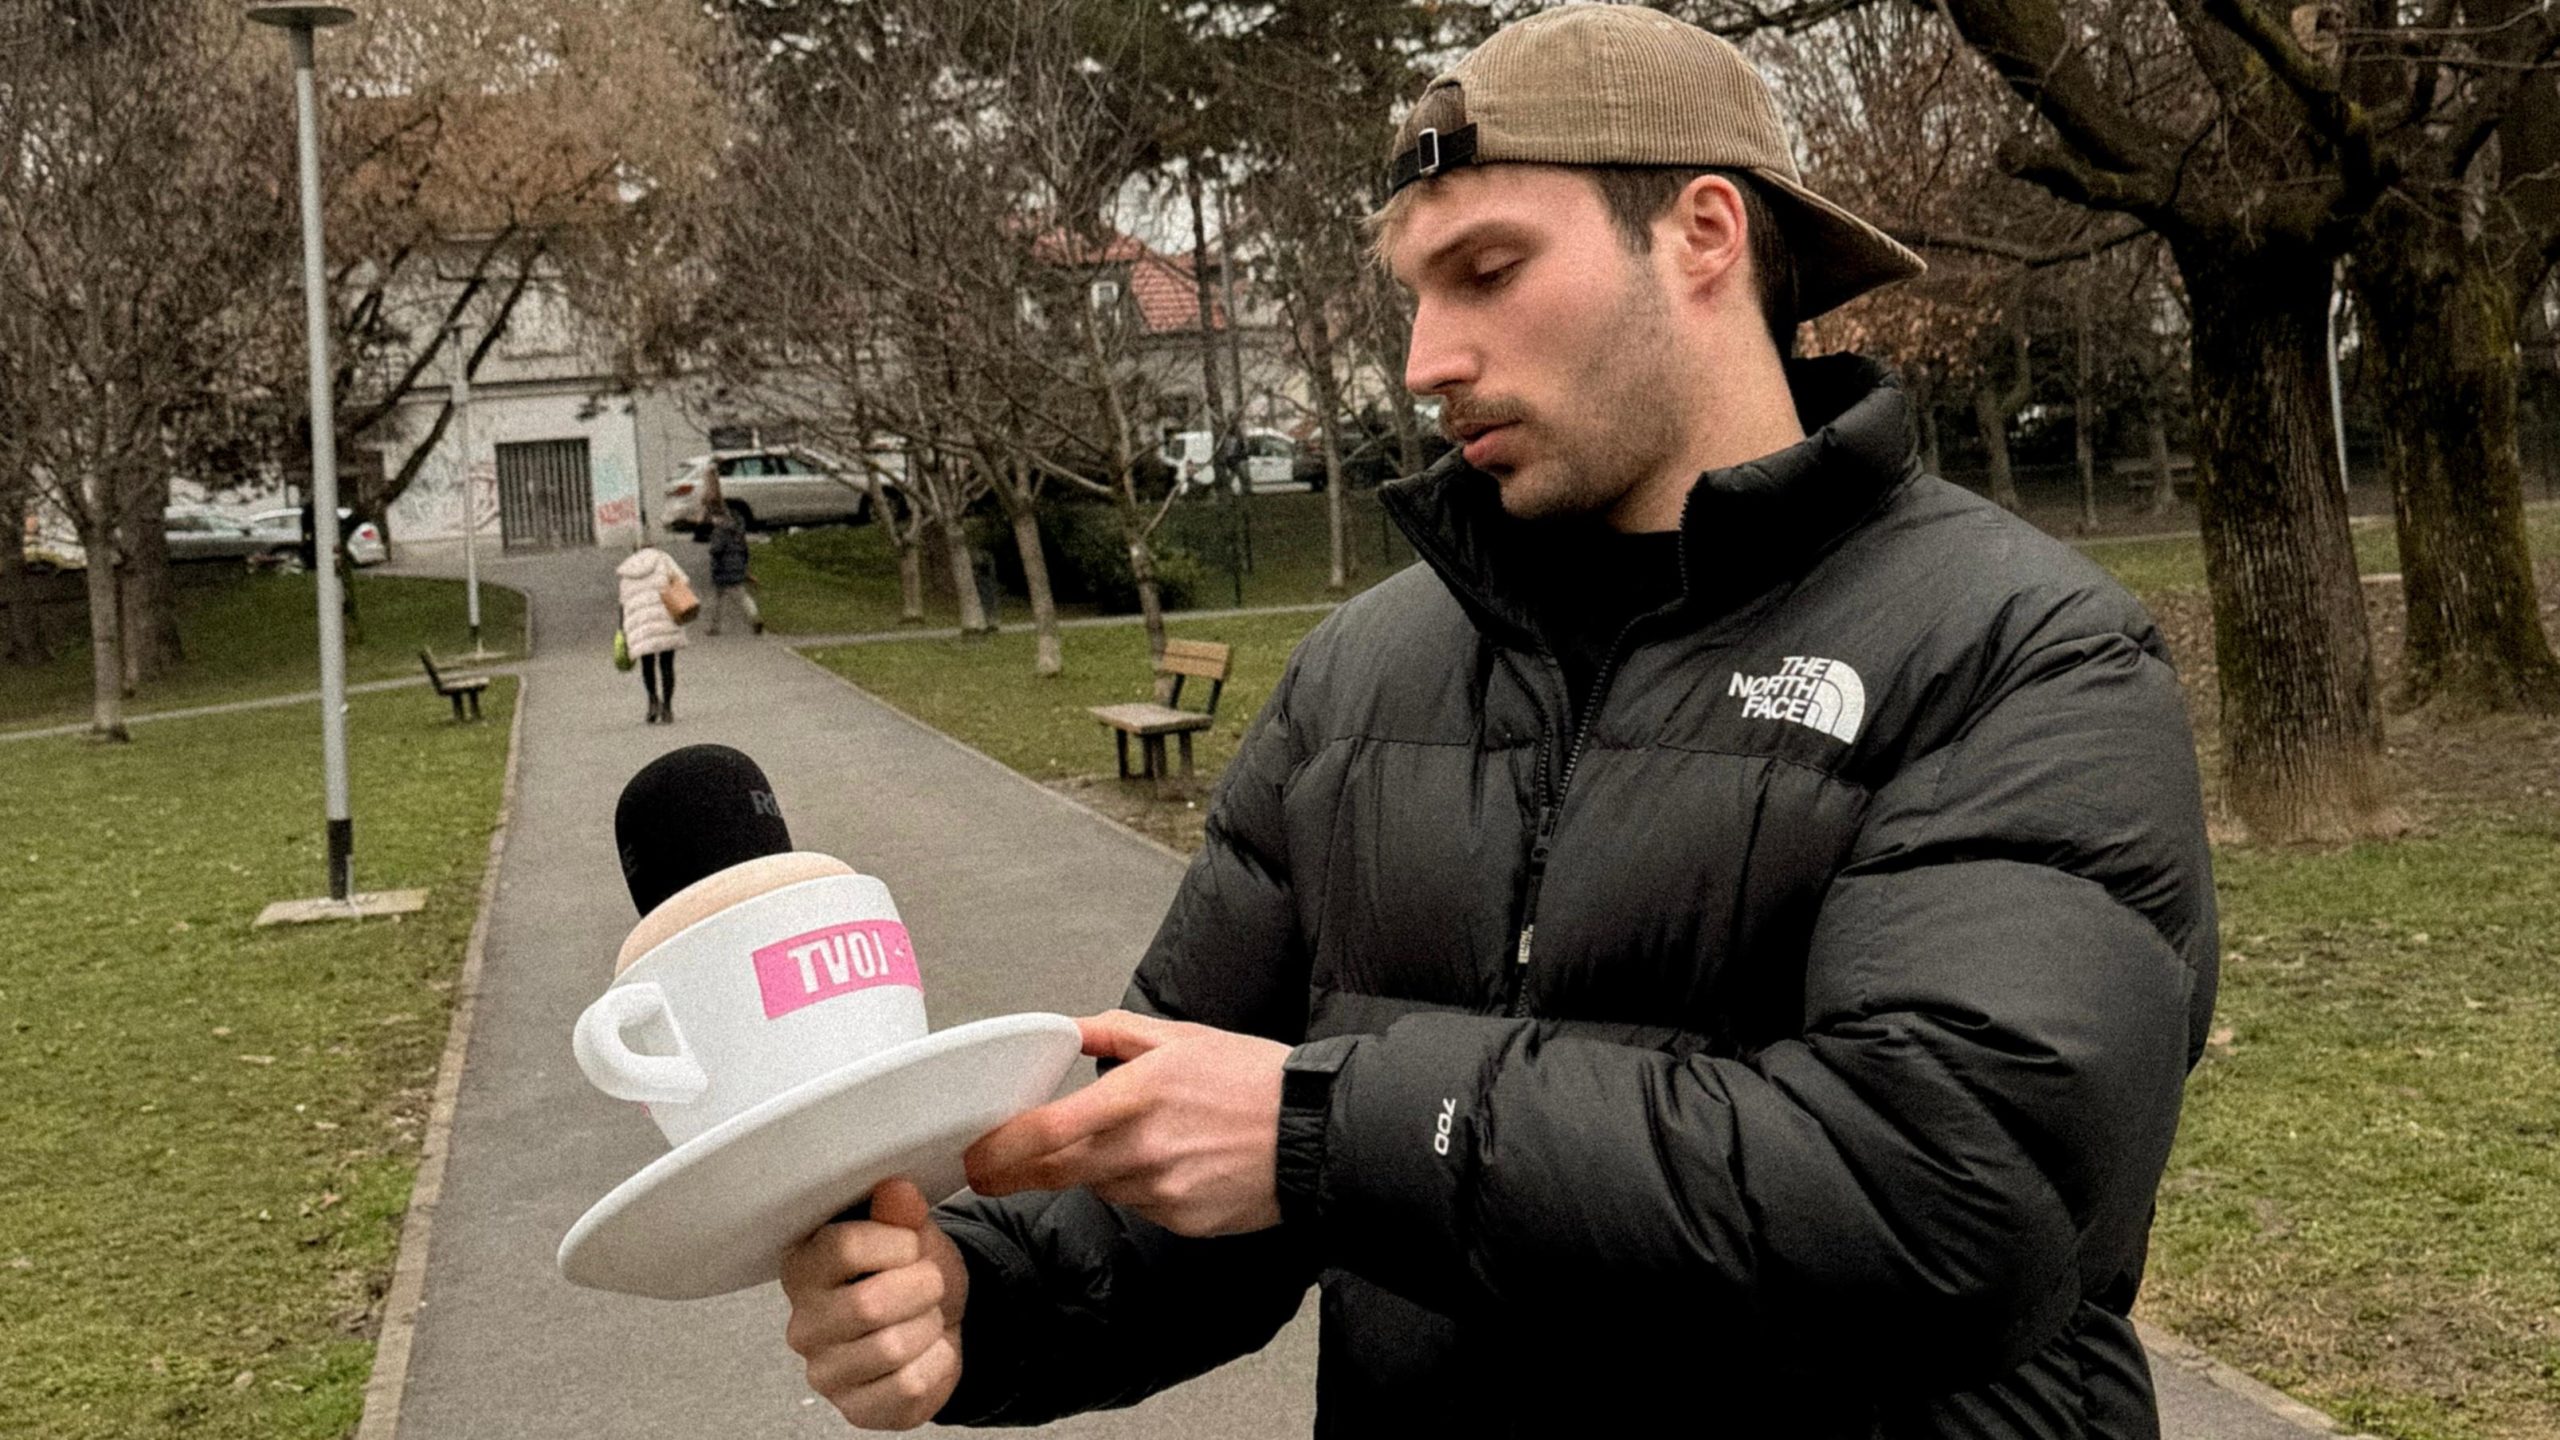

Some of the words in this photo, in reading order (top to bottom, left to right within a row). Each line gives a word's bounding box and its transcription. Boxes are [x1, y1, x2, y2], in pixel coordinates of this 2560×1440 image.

[1780, 656, 1831, 678] THE
[1727, 672, 1817, 700] NORTH
[1741, 697, 1809, 724] FACE
[787, 930, 890, 994] TVOJ
[1434, 1098, 1456, 1156] 700
